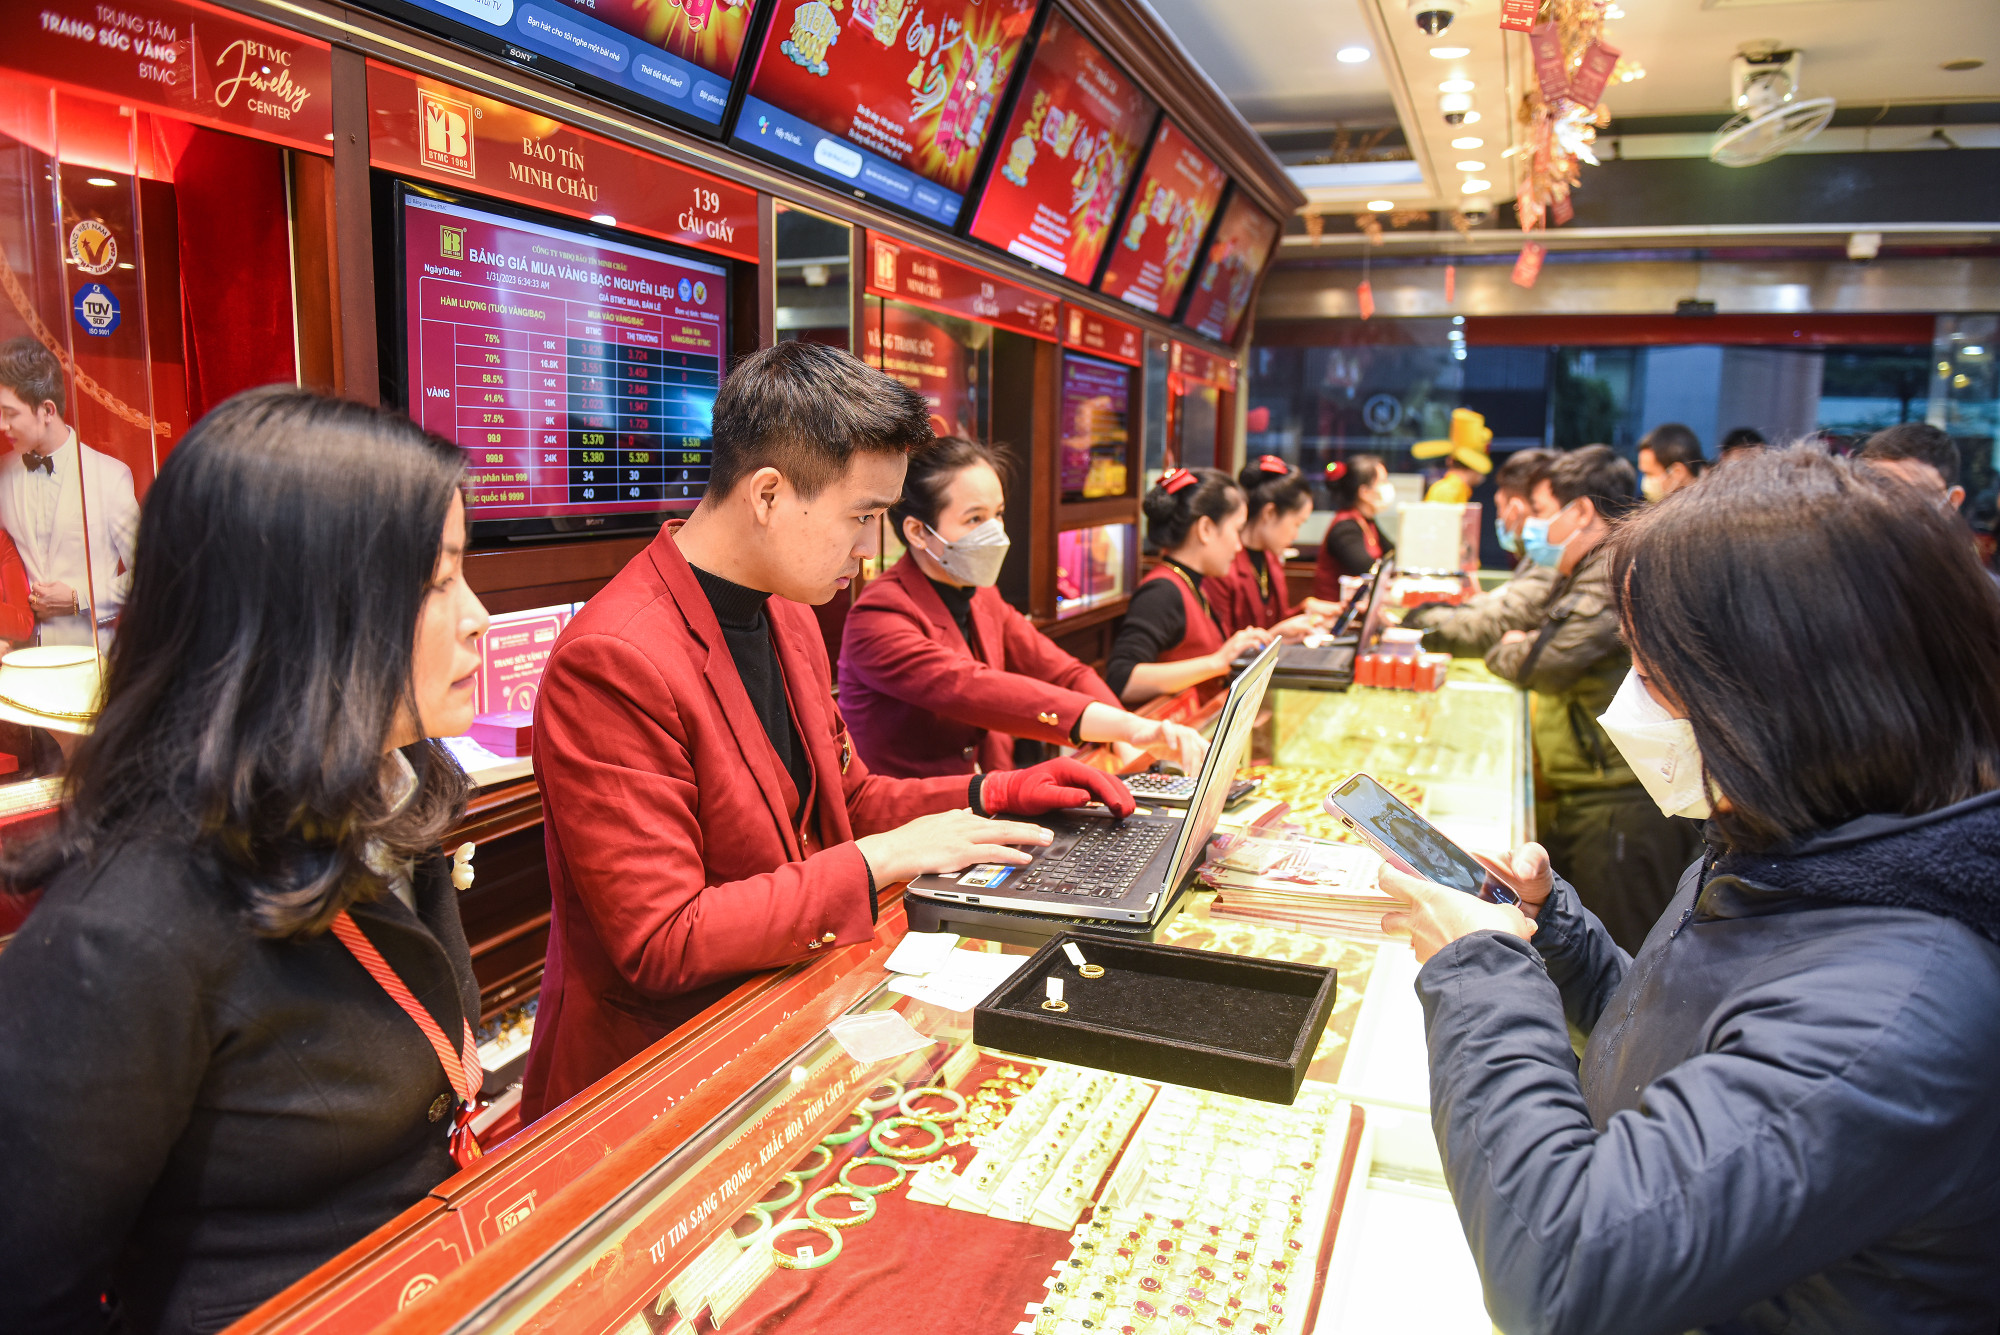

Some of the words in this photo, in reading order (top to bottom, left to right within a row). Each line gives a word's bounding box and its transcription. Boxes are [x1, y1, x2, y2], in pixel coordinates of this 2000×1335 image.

[96, 5, 144, 32] TRUNG
[148, 20, 177, 43] TÂM
[528, 15, 541, 28] Bạn
[552, 26, 564, 38] cho
[573, 36, 587, 48] nghe
[40, 11, 95, 42] TRANG
[99, 25, 131, 51] SỨC
[134, 38, 177, 64] VÀNG
[247, 40, 291, 67] BTMC
[510, 48, 532, 62] SONY
[139, 62, 177, 86] BTMC
[214, 39, 311, 113] Jewelry
[247, 98, 291, 121] CENTER
[428, 150, 449, 164] BTMC
[451, 156, 468, 169] 1989
[522, 136, 556, 163] BẢO
[558, 146, 585, 172] TÍN
[509, 161, 553, 191] MINH
[556, 175, 599, 202] CHÂU
[693, 187, 719, 214] 139
[678, 206, 704, 235] CẦU
[706, 217, 735, 243] GIẤY
[71, 232, 79, 256] HÀNG
[77, 222, 89, 233] VIỆT
[91, 223, 107, 237] NAM
[424, 263, 463, 278] Ngày/Date:
[486, 271, 516, 285] 1/31/2023
[517, 274, 540, 289] 6:34:33
[540, 280, 550, 290] AM
[469, 247, 504, 269] BẢNG
[507, 255, 528, 273] GIÁ
[531, 260, 556, 277] MUA
[557, 264, 588, 283] VÀNG
[591, 273, 611, 289] BẠC
[614, 278, 652, 297] NGUYÊN
[655, 284, 675, 301] LIỆU
[85, 302, 110, 316] TÜV
[440, 295, 457, 309] HÀM
[459, 298, 487, 315] LƯỢNG
[508, 304, 546, 321] VÀNG/BẠC)
[599, 292, 609, 303] GIÁ
[610, 296, 627, 306] BTMC
[588, 309, 602, 320] MUA
[89, 328, 98, 336] ISO
[485, 333, 500, 344] 75%
[543, 340, 556, 350] 18K
[585, 326, 602, 336] BTMC
[485, 353, 500, 364] 70%
[540, 358, 559, 369] 16.8K
[482, 374, 504, 385] 58.5%
[543, 378, 556, 388] 14K
[426, 386, 450, 399] VÀNG
[483, 413, 504, 424] 37.5%
[545, 416, 555, 426] 9K
[487, 433, 502, 444] 99.9
[543, 434, 557, 445] 24K
[582, 433, 605, 446] 5.370
[628, 435, 635, 446] 0
[486, 453, 503, 464] 999.9
[543, 454, 557, 463] 24K
[582, 451, 605, 464] 5.380
[628, 453, 650, 465] 5.320
[483, 472, 500, 485] phân
[500, 473, 514, 482] kim
[515, 471, 528, 482] 999
[582, 470, 594, 482] 34
[628, 470, 640, 482] 30
[682, 469, 690, 481] 0
[480, 491, 499, 504] quốc
[507, 490, 525, 502] 9999
[583, 487, 595, 499] 40
[628, 486, 640, 498] 40
[682, 486, 690, 497] 0
[649, 1233, 665, 1266] TỰ
[667, 1218, 688, 1249] TIN
[689, 1196, 718, 1231] SANG
[717, 1161, 753, 1207] TRỌNG
[759, 1129, 787, 1169] KHẮC
[784, 1116, 804, 1146] HOẠ
[803, 1100, 826, 1127] TÍNH
[825, 1079, 845, 1108] CÁCH
